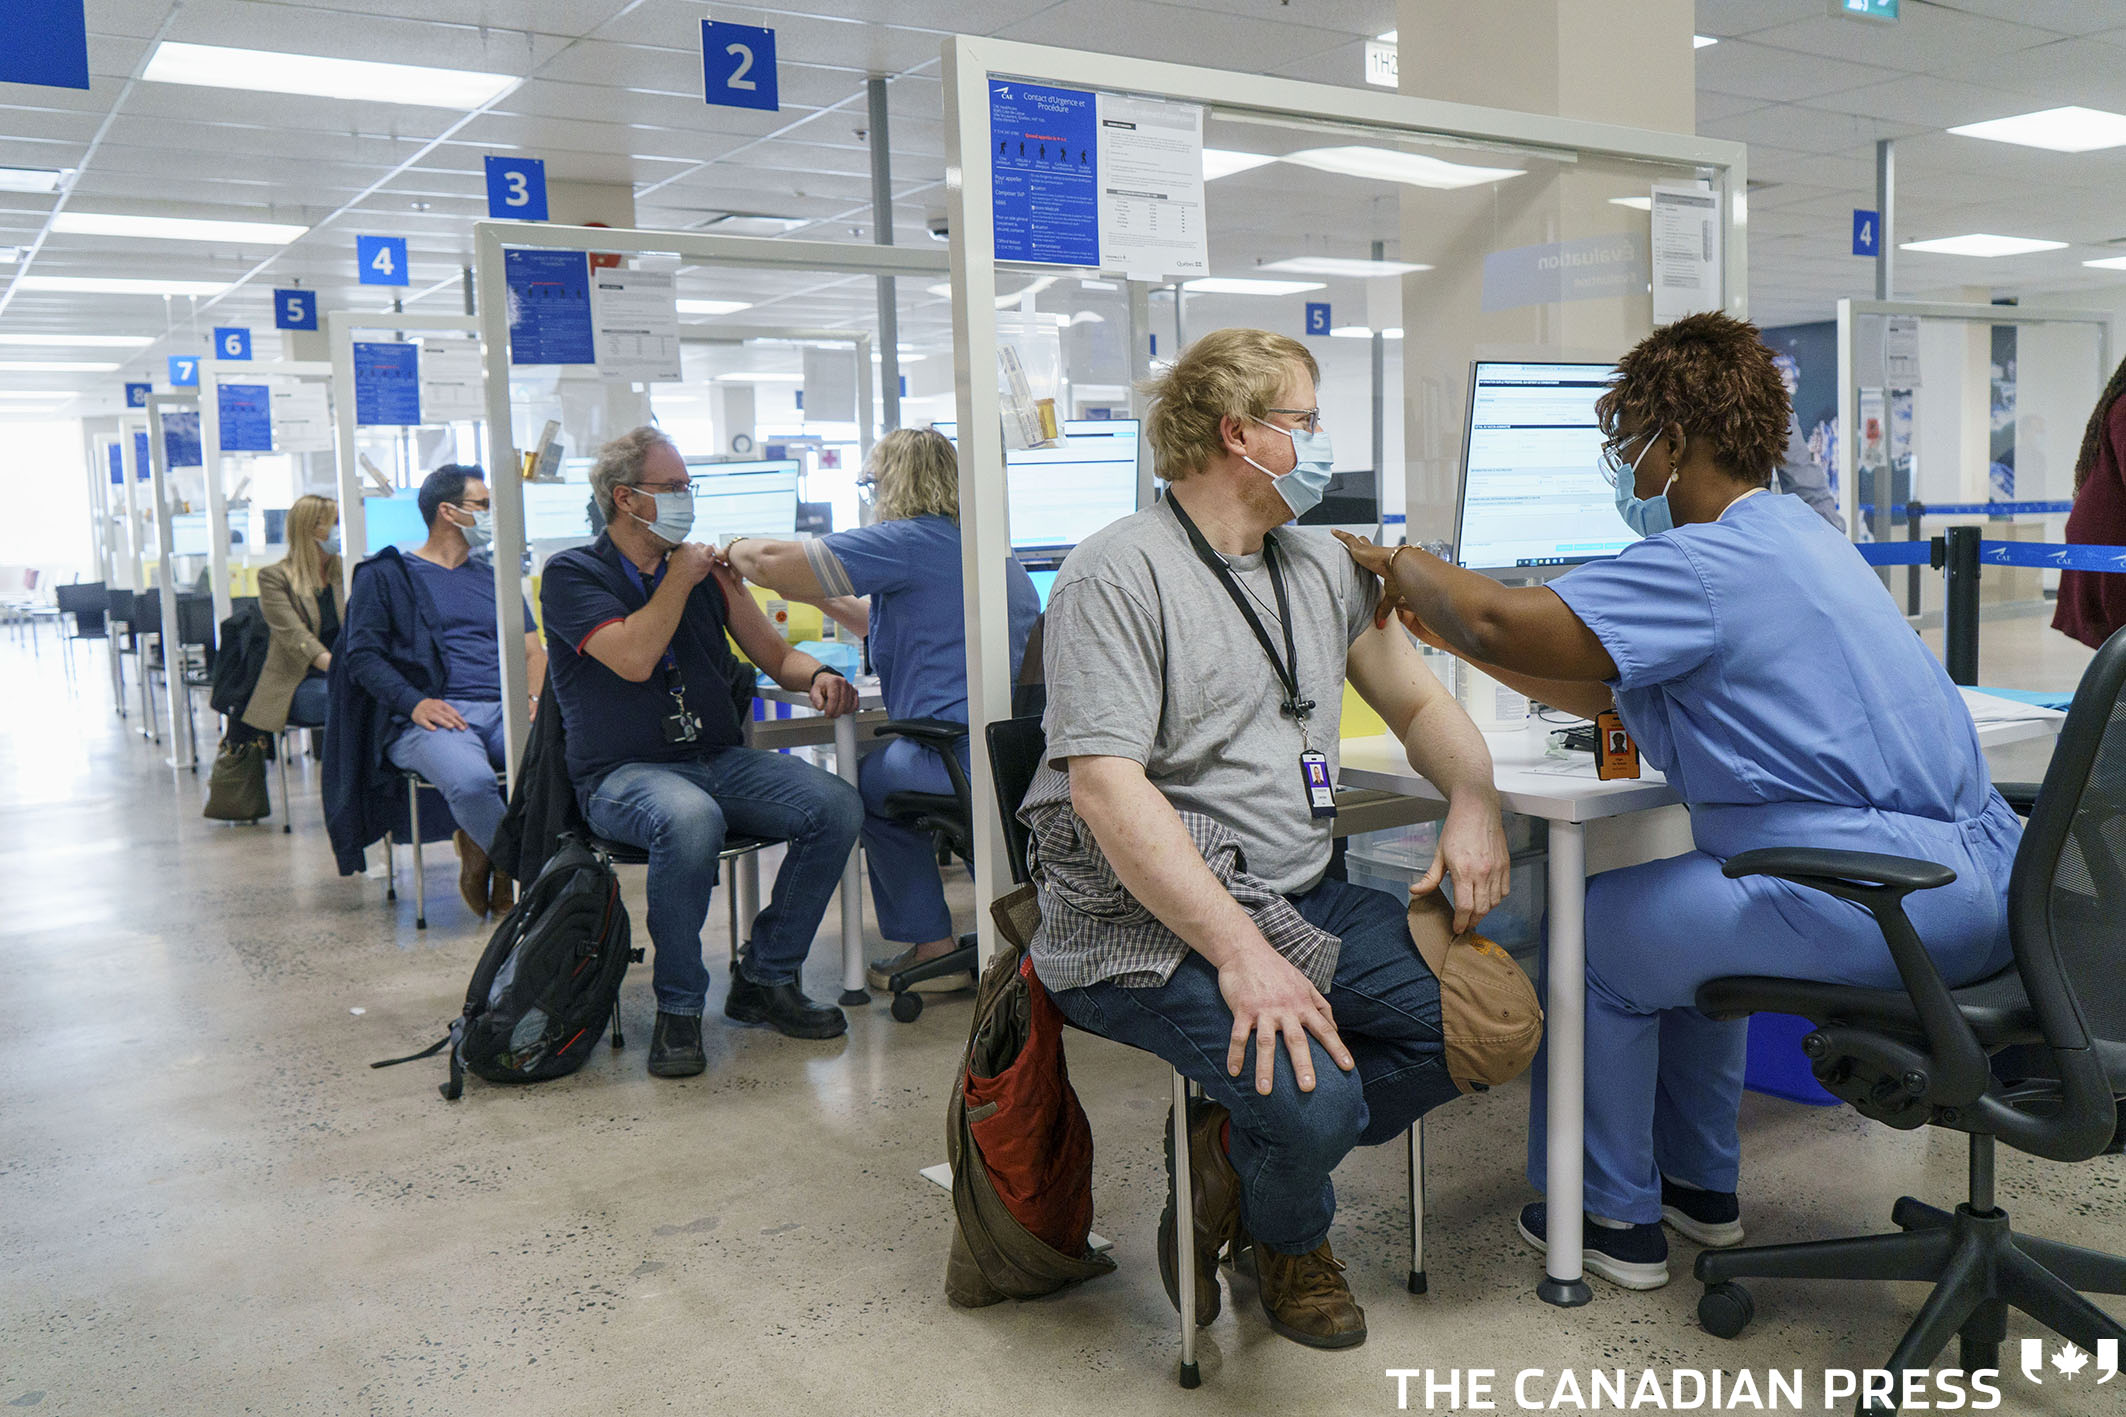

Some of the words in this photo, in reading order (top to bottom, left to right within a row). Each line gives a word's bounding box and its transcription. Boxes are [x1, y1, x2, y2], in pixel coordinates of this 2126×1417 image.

[726, 43, 757, 91] 2
[1023, 92, 1047, 102] Contact
[1048, 95, 1078, 107] d'Urgence
[1078, 100, 1086, 108] et
[1037, 102, 1070, 114] Procédure
[504, 171, 529, 207] 3
[1860, 220, 1873, 247] 4
[372, 247, 395, 276] 4
[287, 298, 305, 322] 5
[1312, 310, 1325, 329] 5
[225, 334, 242, 356] 6
[177, 361, 194, 381] 7
[133, 388, 146, 404] 8
